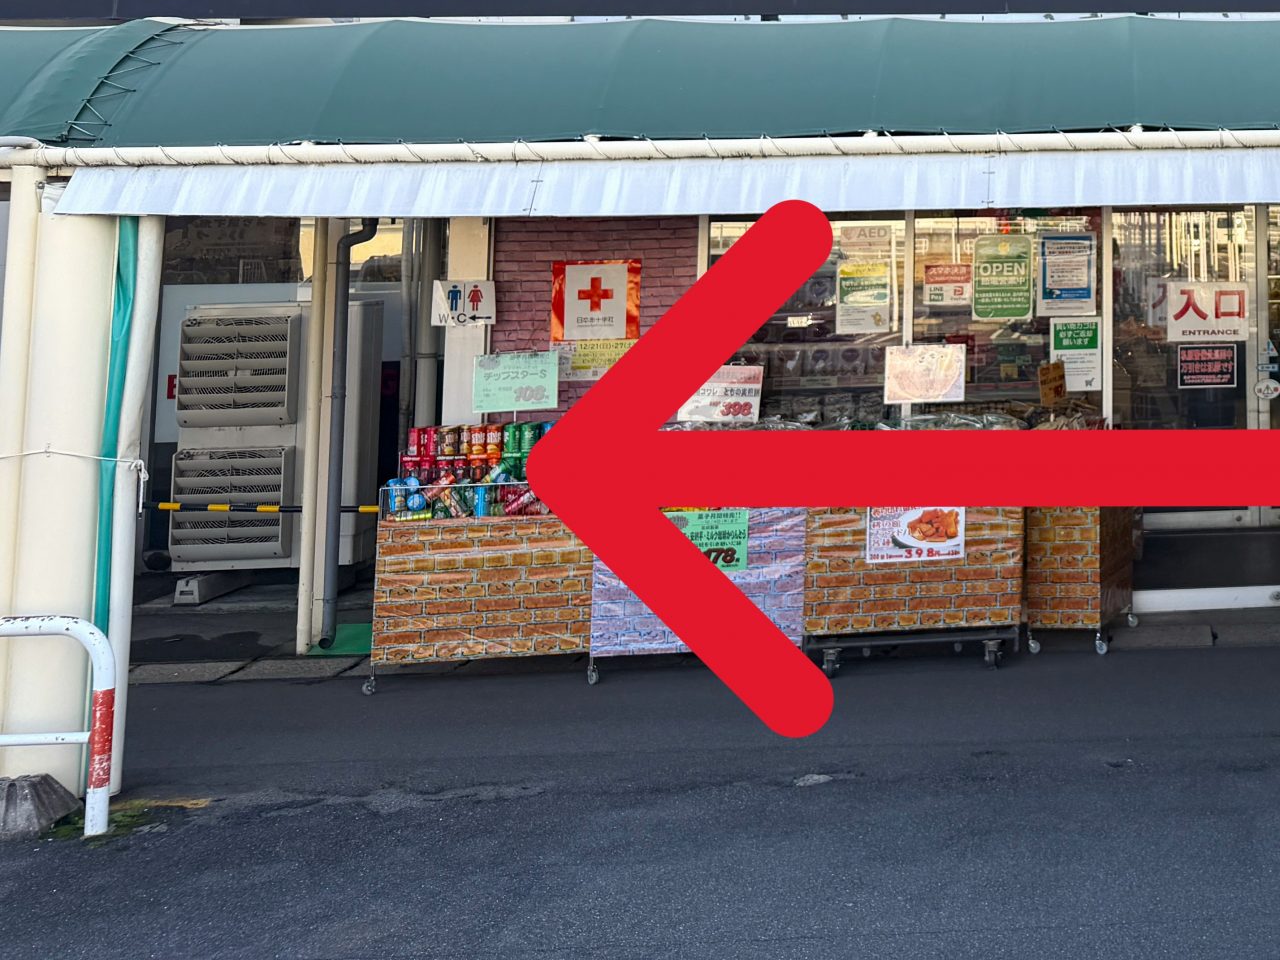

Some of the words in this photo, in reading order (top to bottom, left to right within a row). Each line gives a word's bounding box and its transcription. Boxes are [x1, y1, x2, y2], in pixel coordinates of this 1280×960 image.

[857, 228, 888, 239] AED
[980, 262, 1026, 276] OPEN
[1173, 289, 1245, 321] 入口
[1181, 328, 1240, 336] ENTRANCE
